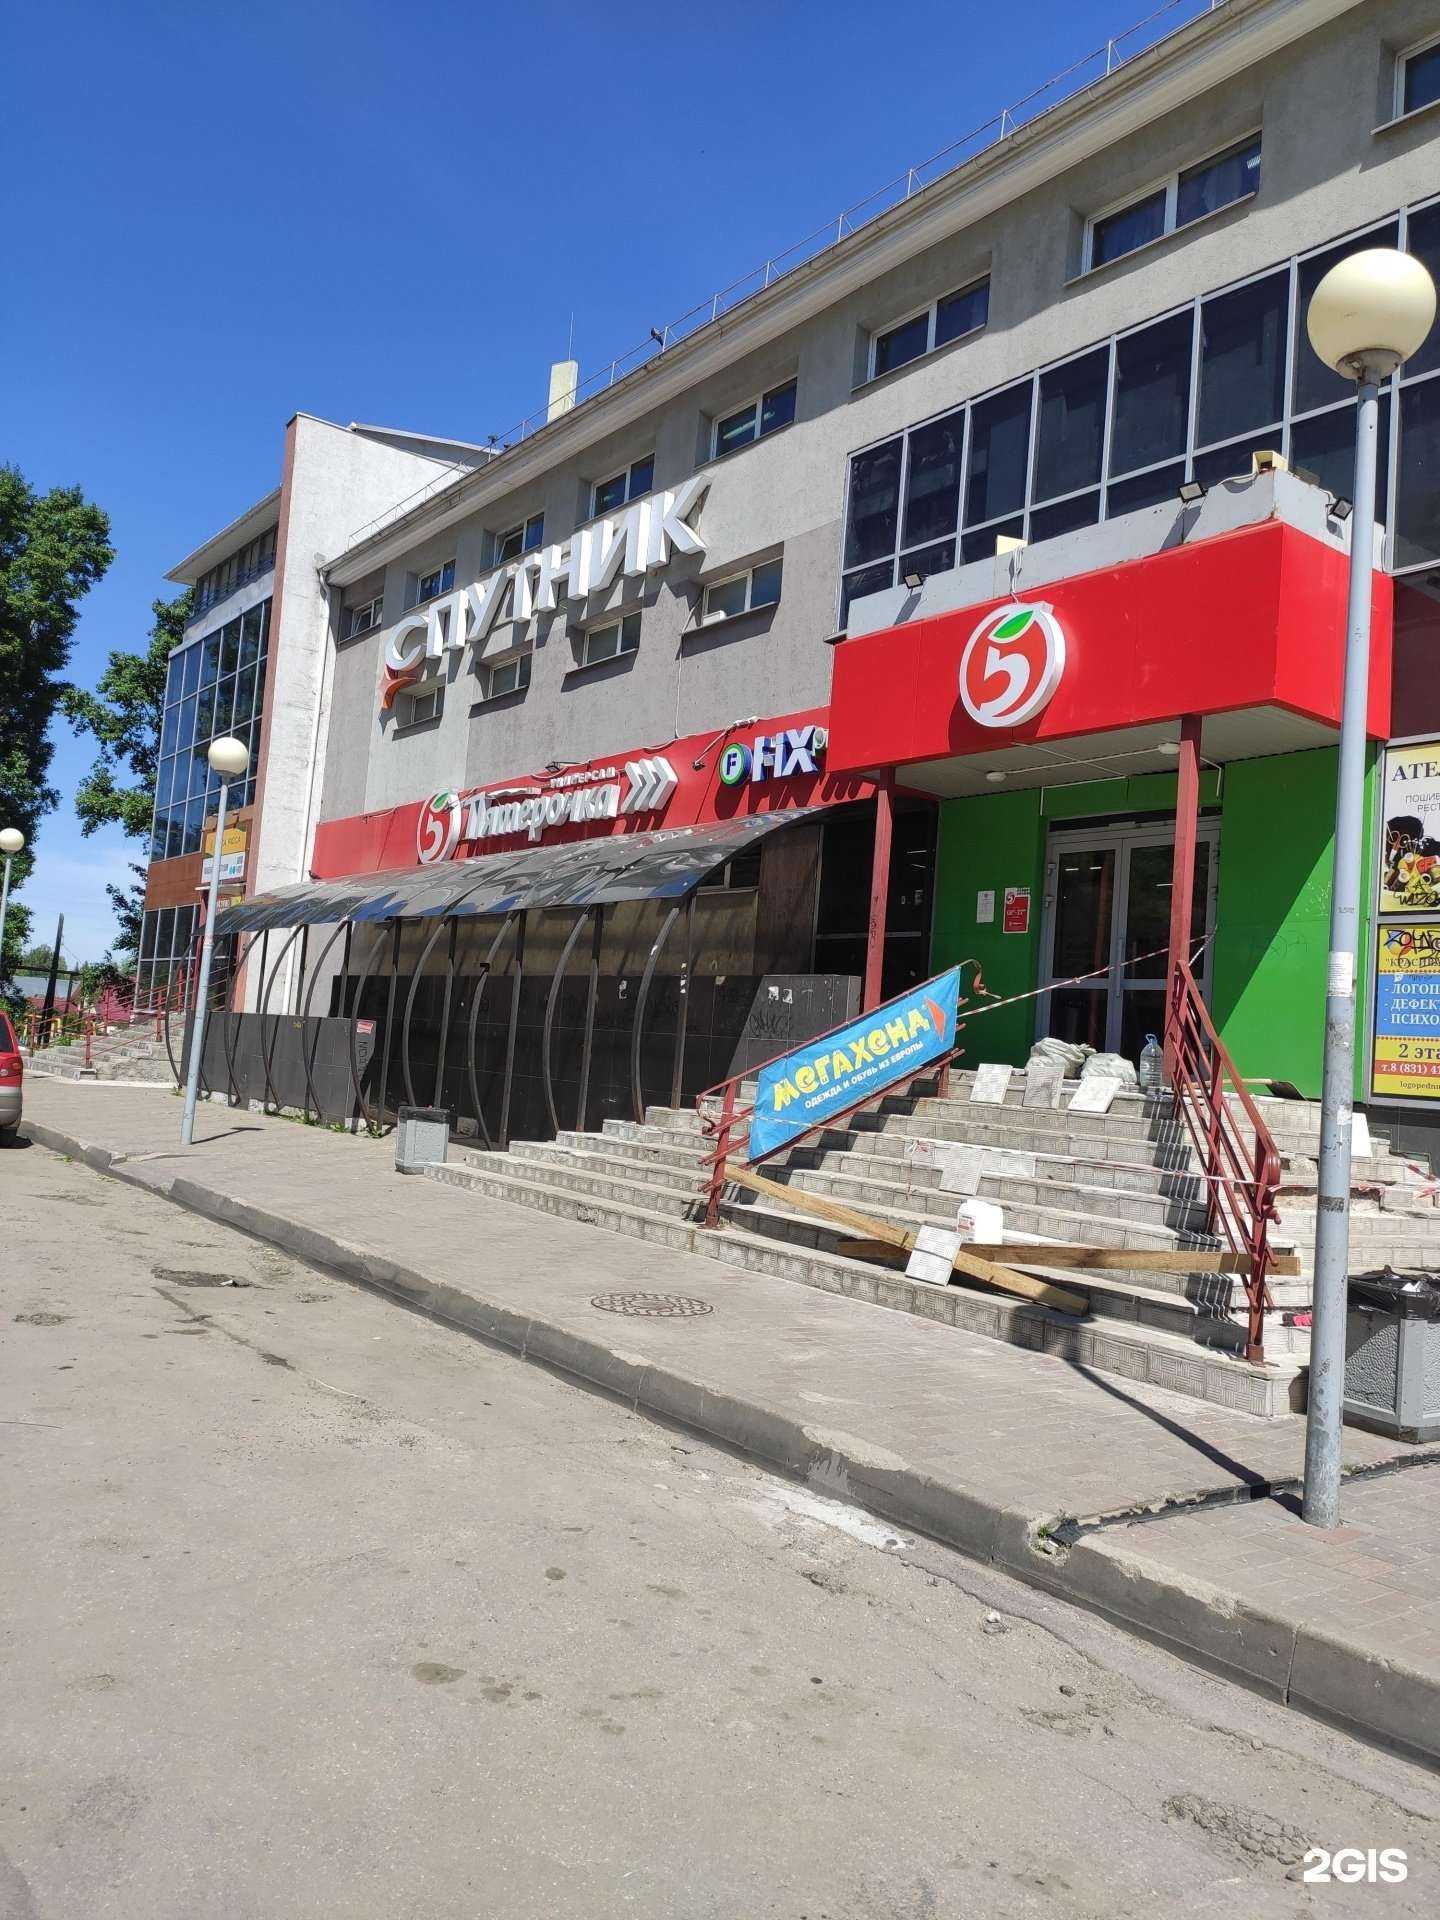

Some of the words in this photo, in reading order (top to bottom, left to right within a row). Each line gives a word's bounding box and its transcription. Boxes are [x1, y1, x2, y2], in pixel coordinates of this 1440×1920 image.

[385, 474, 711, 671] СПУТНИК
[1392, 761, 1440, 781] АТЕ
[1398, 1043, 1409, 1058] 2
[804, 1085, 843, 1109] ОДЕЖДА
[851, 1067, 878, 1085] ОБУВЬ
[879, 1059, 890, 1070] ИЗ
[891, 1041, 924, 1064] ЕВРОПЫ
